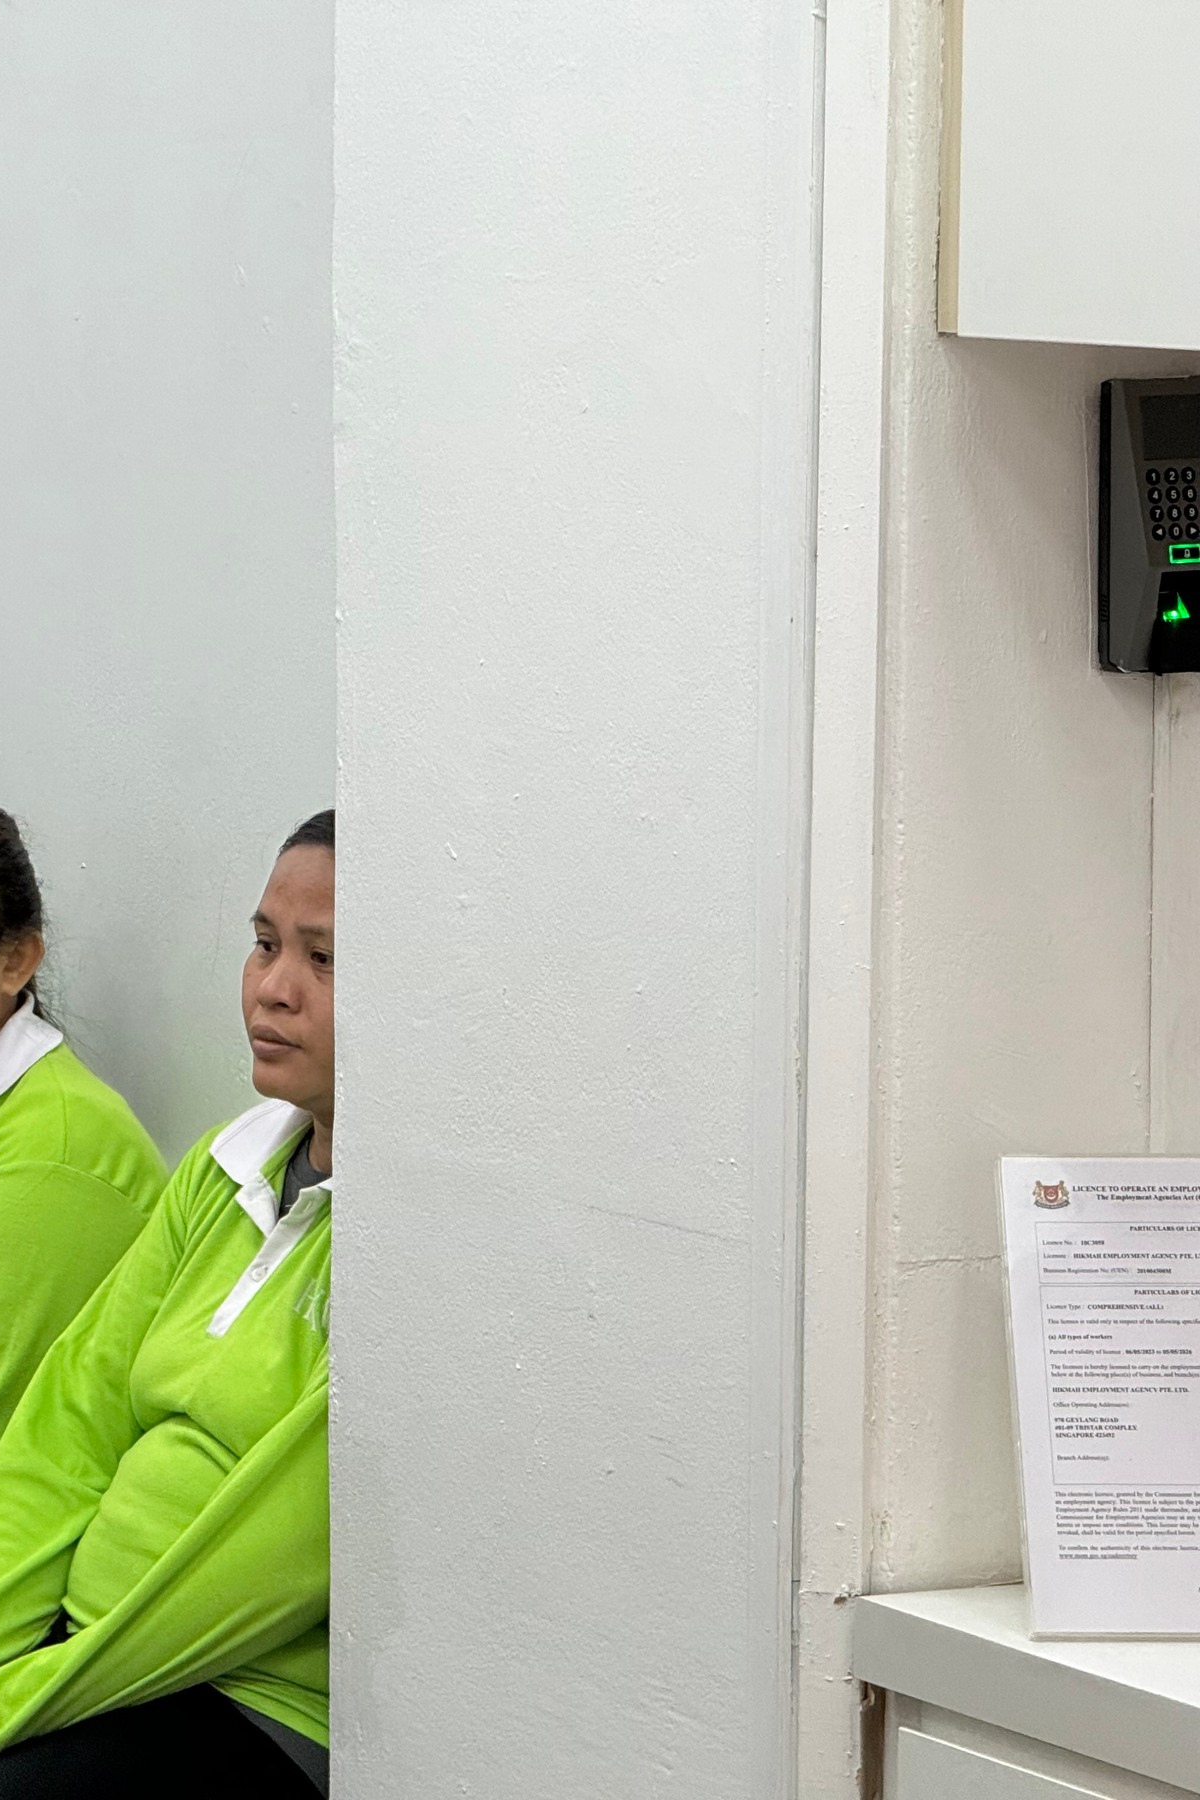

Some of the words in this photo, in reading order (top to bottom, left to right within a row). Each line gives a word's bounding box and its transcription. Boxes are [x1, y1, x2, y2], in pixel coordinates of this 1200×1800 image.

[1151, 472, 1156, 482] 1
[1169, 471, 1175, 480] 2
[1186, 470, 1192, 480] 3
[1152, 490, 1159, 500] 4
[1170, 490, 1177, 499] 5
[1187, 489, 1193, 498] 6
[1155, 509, 1161, 518] 7
[1172, 508, 1178, 518] 8
[1188, 507, 1195, 517] 9
[1173, 526, 1179, 536] 0
